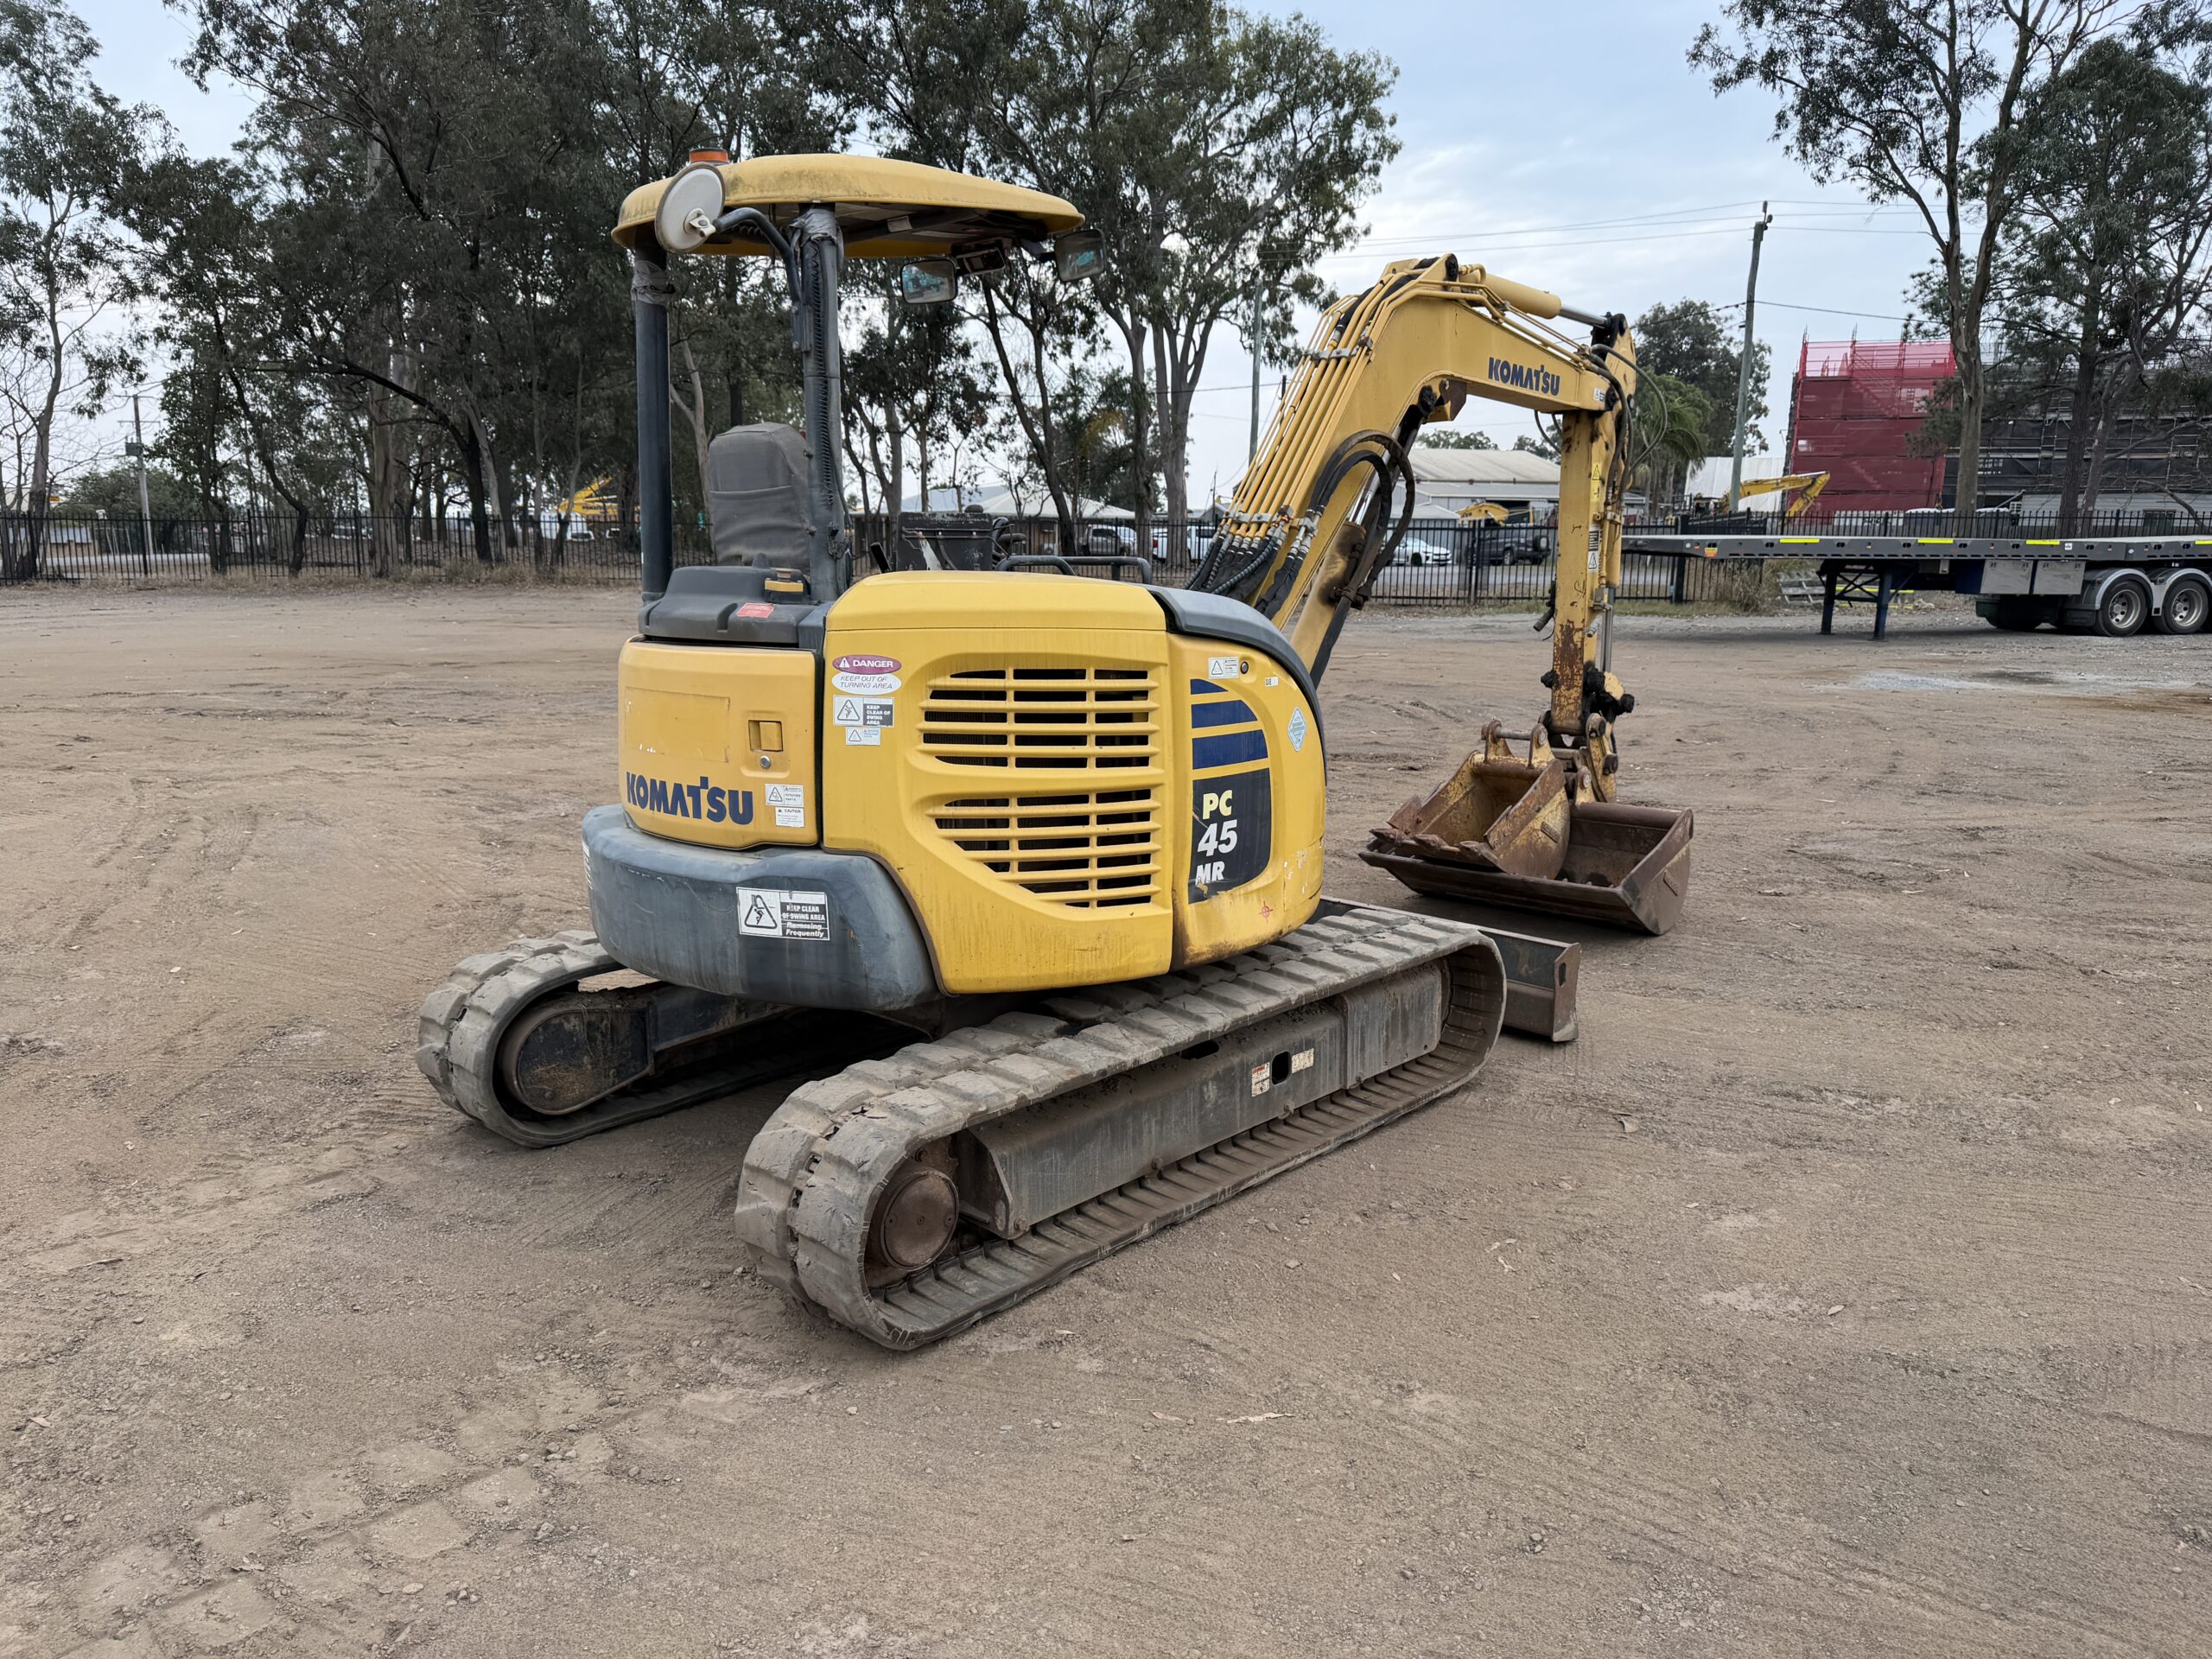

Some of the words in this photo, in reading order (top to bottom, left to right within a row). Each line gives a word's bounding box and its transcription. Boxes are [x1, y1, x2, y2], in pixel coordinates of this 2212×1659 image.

[1488, 357, 1560, 397] KOMATSU
[853, 659, 893, 668] DANGER
[626, 771, 754, 826] KOMATSU
[1202, 789, 1233, 820] PC
[1197, 819, 1238, 858] 45
[1195, 861, 1225, 885] MR
[785, 929, 825, 938] Frequently
